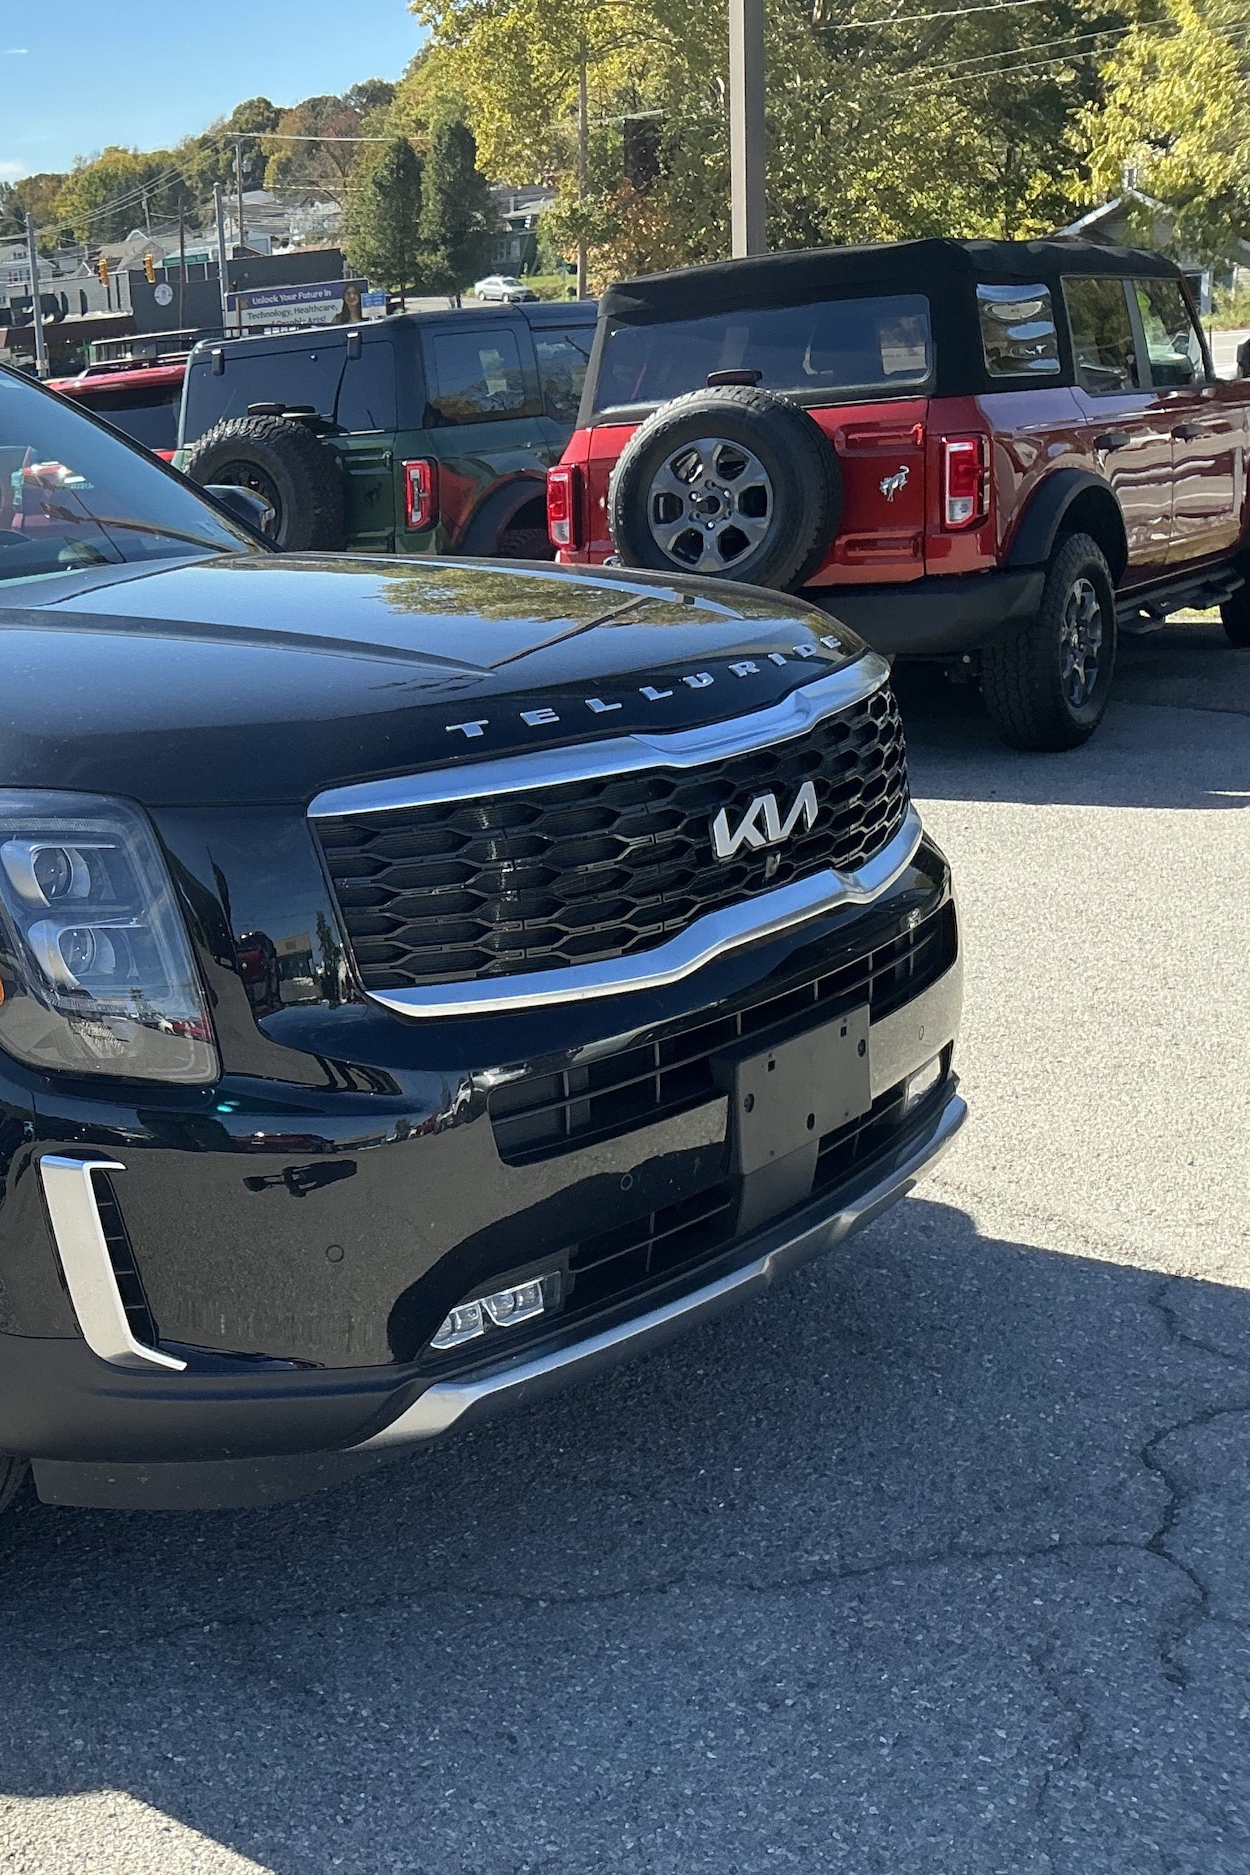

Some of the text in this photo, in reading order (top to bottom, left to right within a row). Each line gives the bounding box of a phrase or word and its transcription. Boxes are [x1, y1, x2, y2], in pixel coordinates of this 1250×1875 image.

[252, 294, 279, 305] Unlock
[279, 293, 297, 302] Your
[297, 290, 323, 300] Future
[247, 303, 338, 320] Technology, Healthcare,
[445, 634, 842, 738] TELLURIDE
